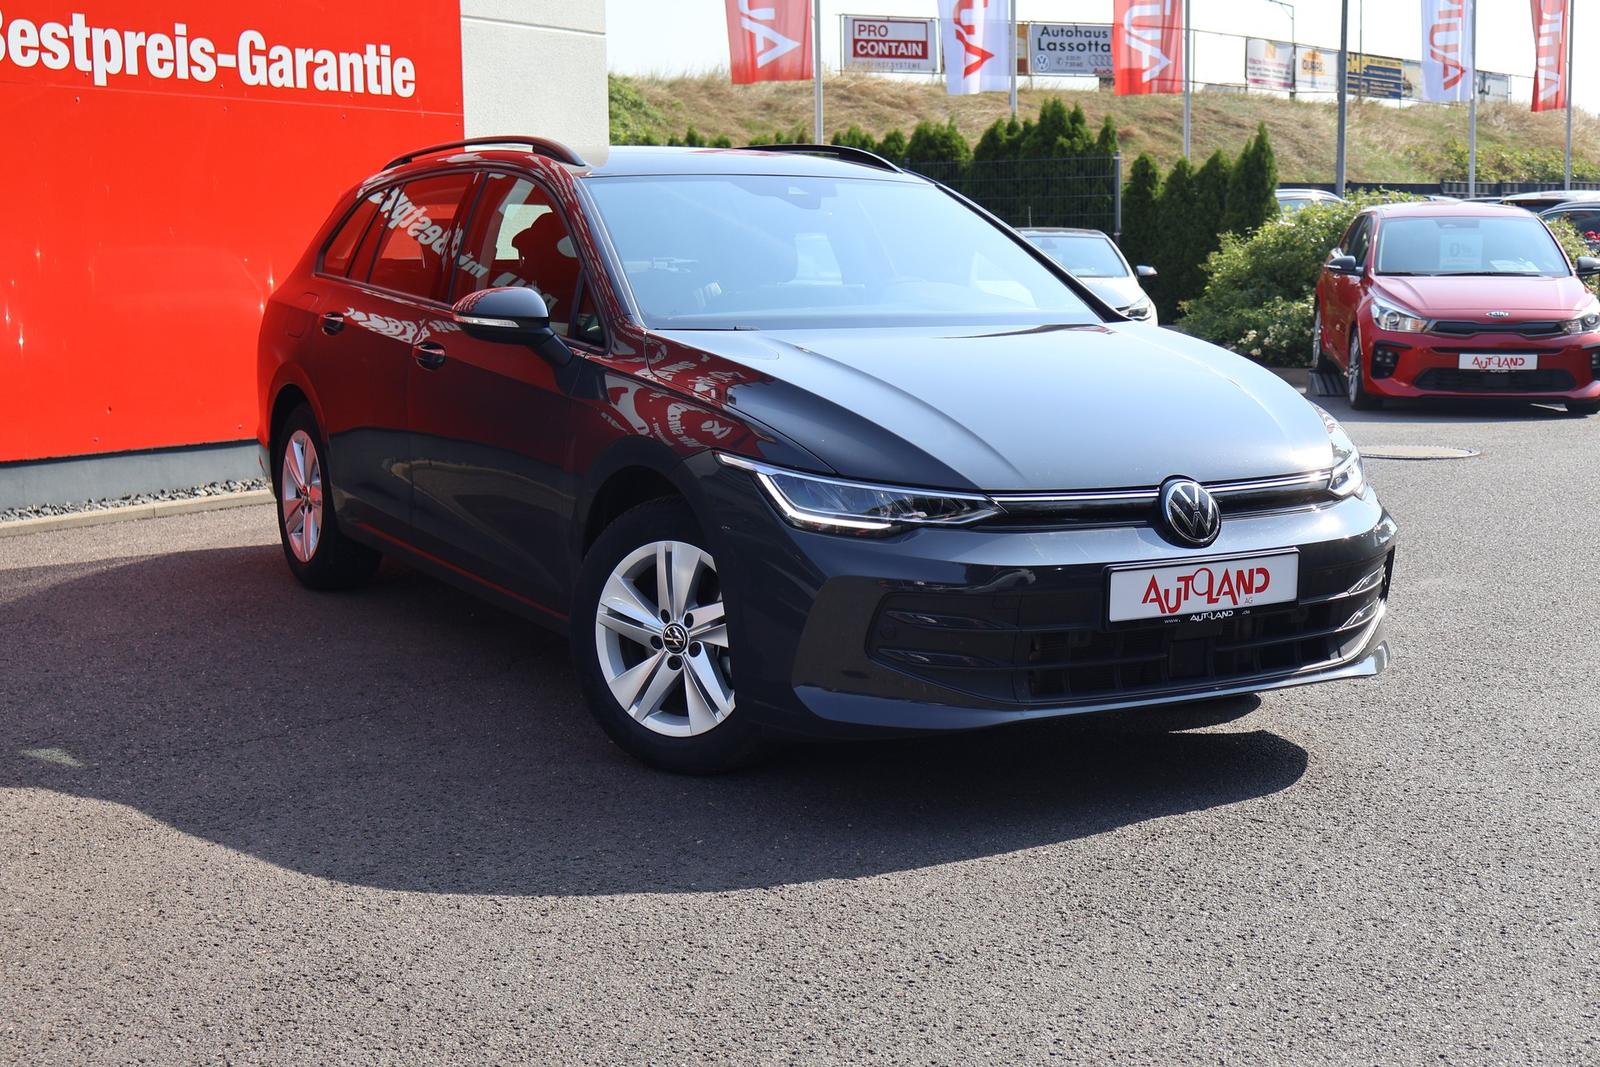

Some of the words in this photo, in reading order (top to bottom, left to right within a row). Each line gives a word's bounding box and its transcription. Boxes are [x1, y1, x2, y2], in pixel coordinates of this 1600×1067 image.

[858, 24, 889, 38] PRO
[1040, 25, 1108, 38] Autohaus
[856, 41, 922, 56] CONTAIN
[1038, 38, 1111, 52] Lassotta
[0, 8, 416, 98] estpreis-Garantie
[1141, 567, 1270, 614] AUTOLAND
